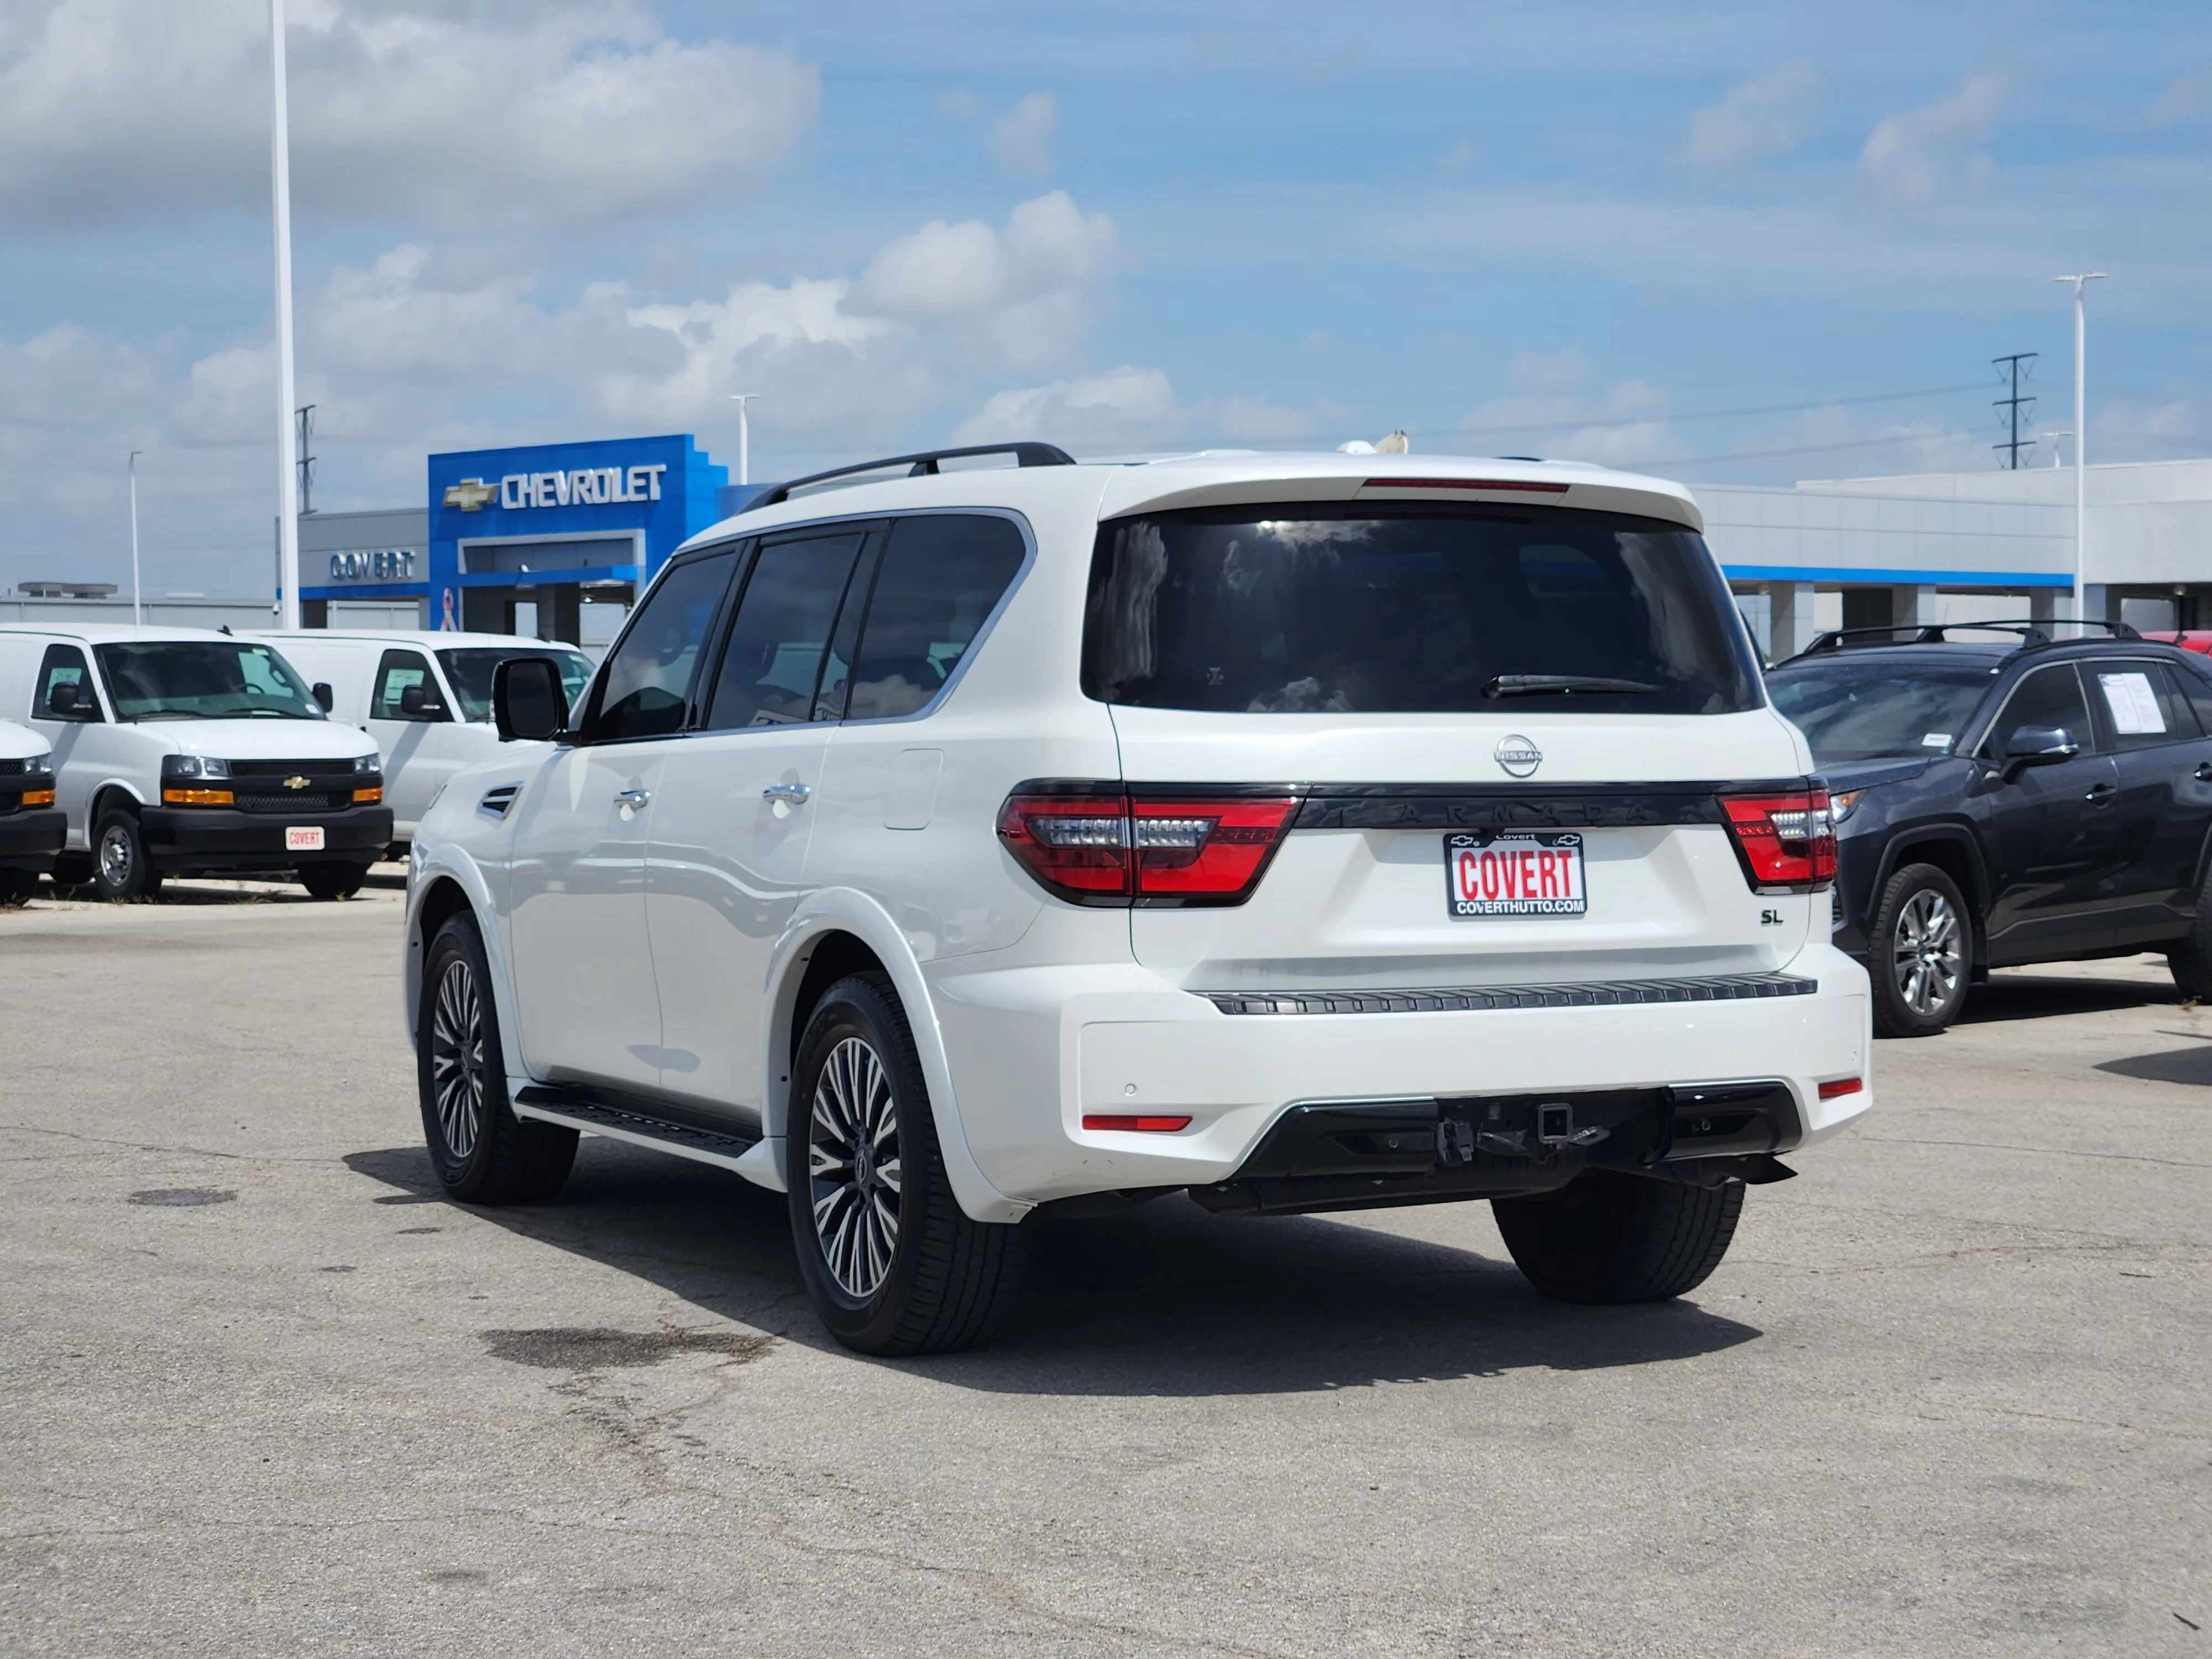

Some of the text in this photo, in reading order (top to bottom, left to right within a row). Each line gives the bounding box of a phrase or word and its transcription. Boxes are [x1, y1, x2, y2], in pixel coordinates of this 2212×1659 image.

[502, 464, 667, 509] CHEVROLET
[331, 550, 415, 580] COVERT
[1400, 804, 1649, 823] ARMADA
[289, 832, 319, 844] COVERT
[1459, 850, 1572, 900] COVERT
[1457, 900, 1584, 914] COVERTHUTTO.COM
[1760, 909, 1784, 924] SL
